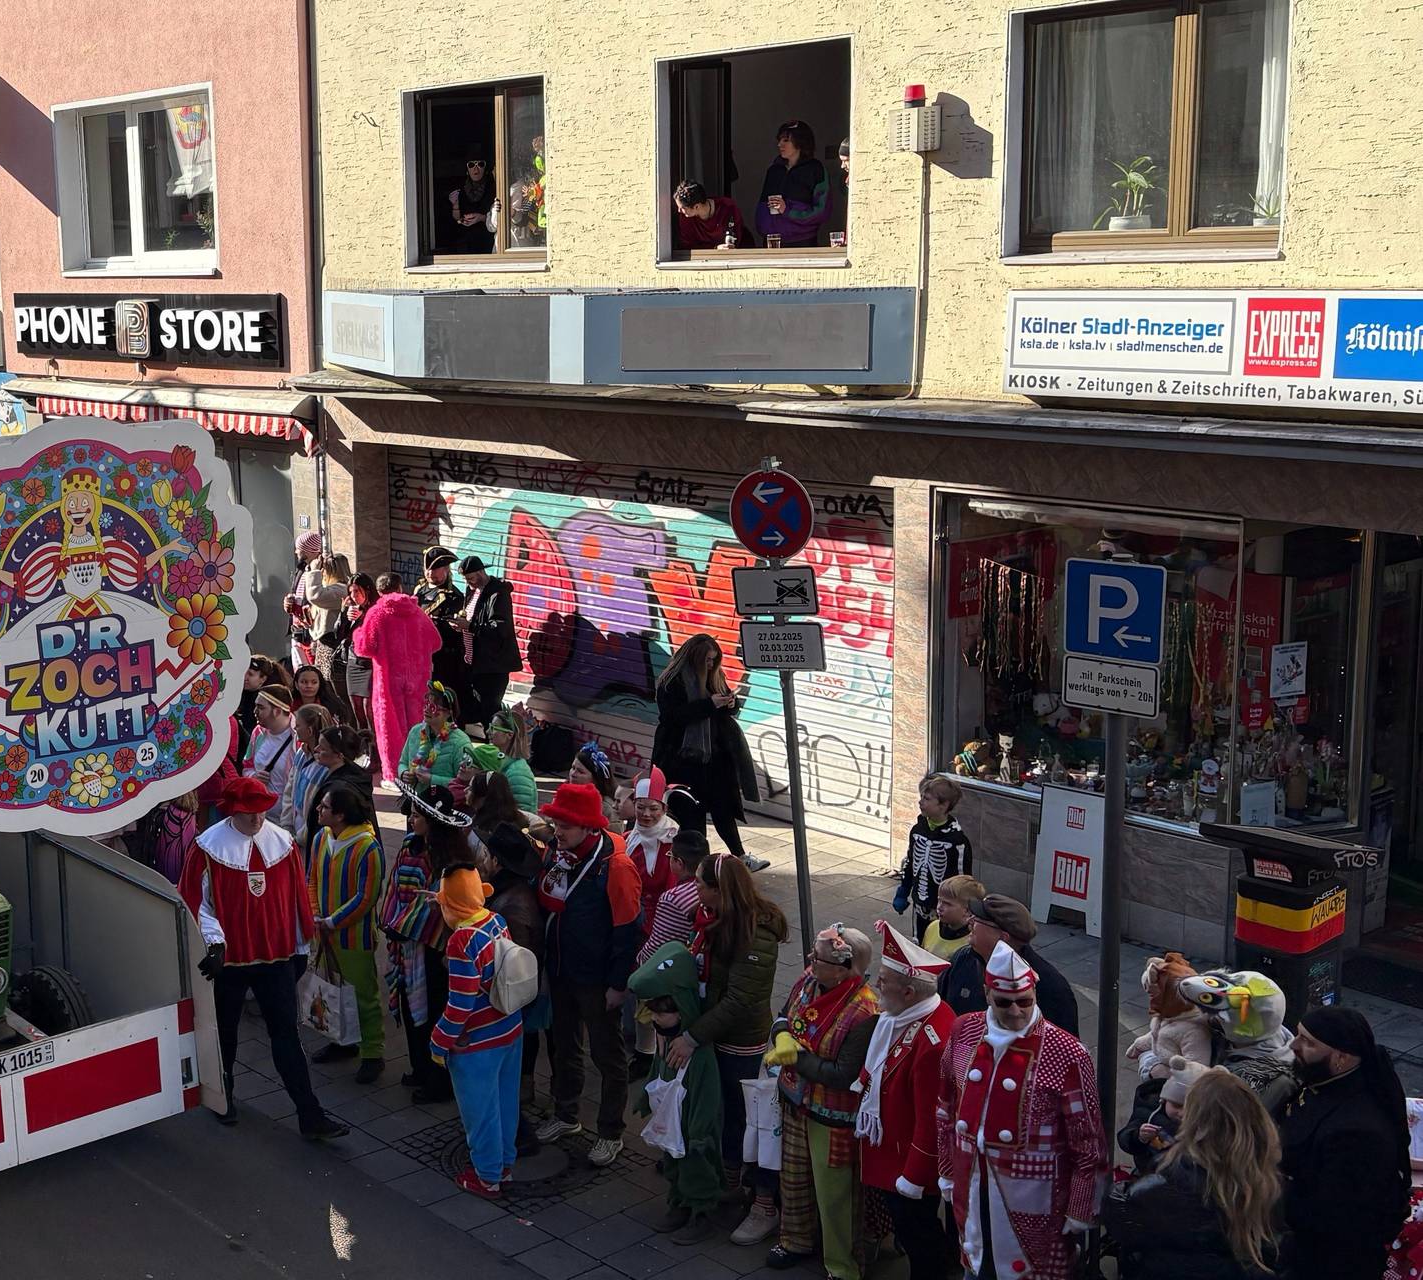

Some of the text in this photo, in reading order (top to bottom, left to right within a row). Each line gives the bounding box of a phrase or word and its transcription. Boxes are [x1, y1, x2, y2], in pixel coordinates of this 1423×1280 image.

[14, 306, 262, 352] PHONE STORE
[1021, 316, 1224, 341] Kölner Stadt-Anzeiger
[1248, 311, 1321, 359] EXPRESS
[1020, 338, 1224, 355] ksta.de ksta.tv stadtmenschen.de
[1248, 358, 1318, 367] www.express.de
[1008, 374, 1060, 390] KIOSK
[1077, 377, 1153, 396] Zeitungen
[1157, 380, 1167, 394] &
[1171, 381, 1282, 401] Zeitschriften,
[1287, 385, 1398, 406] Tabakwaren,
[1087, 574, 1139, 644] P
[40, 616, 122, 659] D'R
[759, 644, 804, 652] 02.03.2025
[760, 655, 805, 663] 03.03.2025
[8, 645, 153, 711] ZOCH
[1097, 672, 1142, 688] Parkschein
[1068, 683, 1104, 696] werktags
[1106, 689, 1120, 698] von
[1138, 691, 1153, 703] 20h
[35, 692, 150, 756] KÜTT
[30, 746, 155, 784] 20 25
[1068, 807, 1086, 824] Bild
[1055, 856, 1087, 894] Bild
[10, 1047, 43, 1071] 1015
